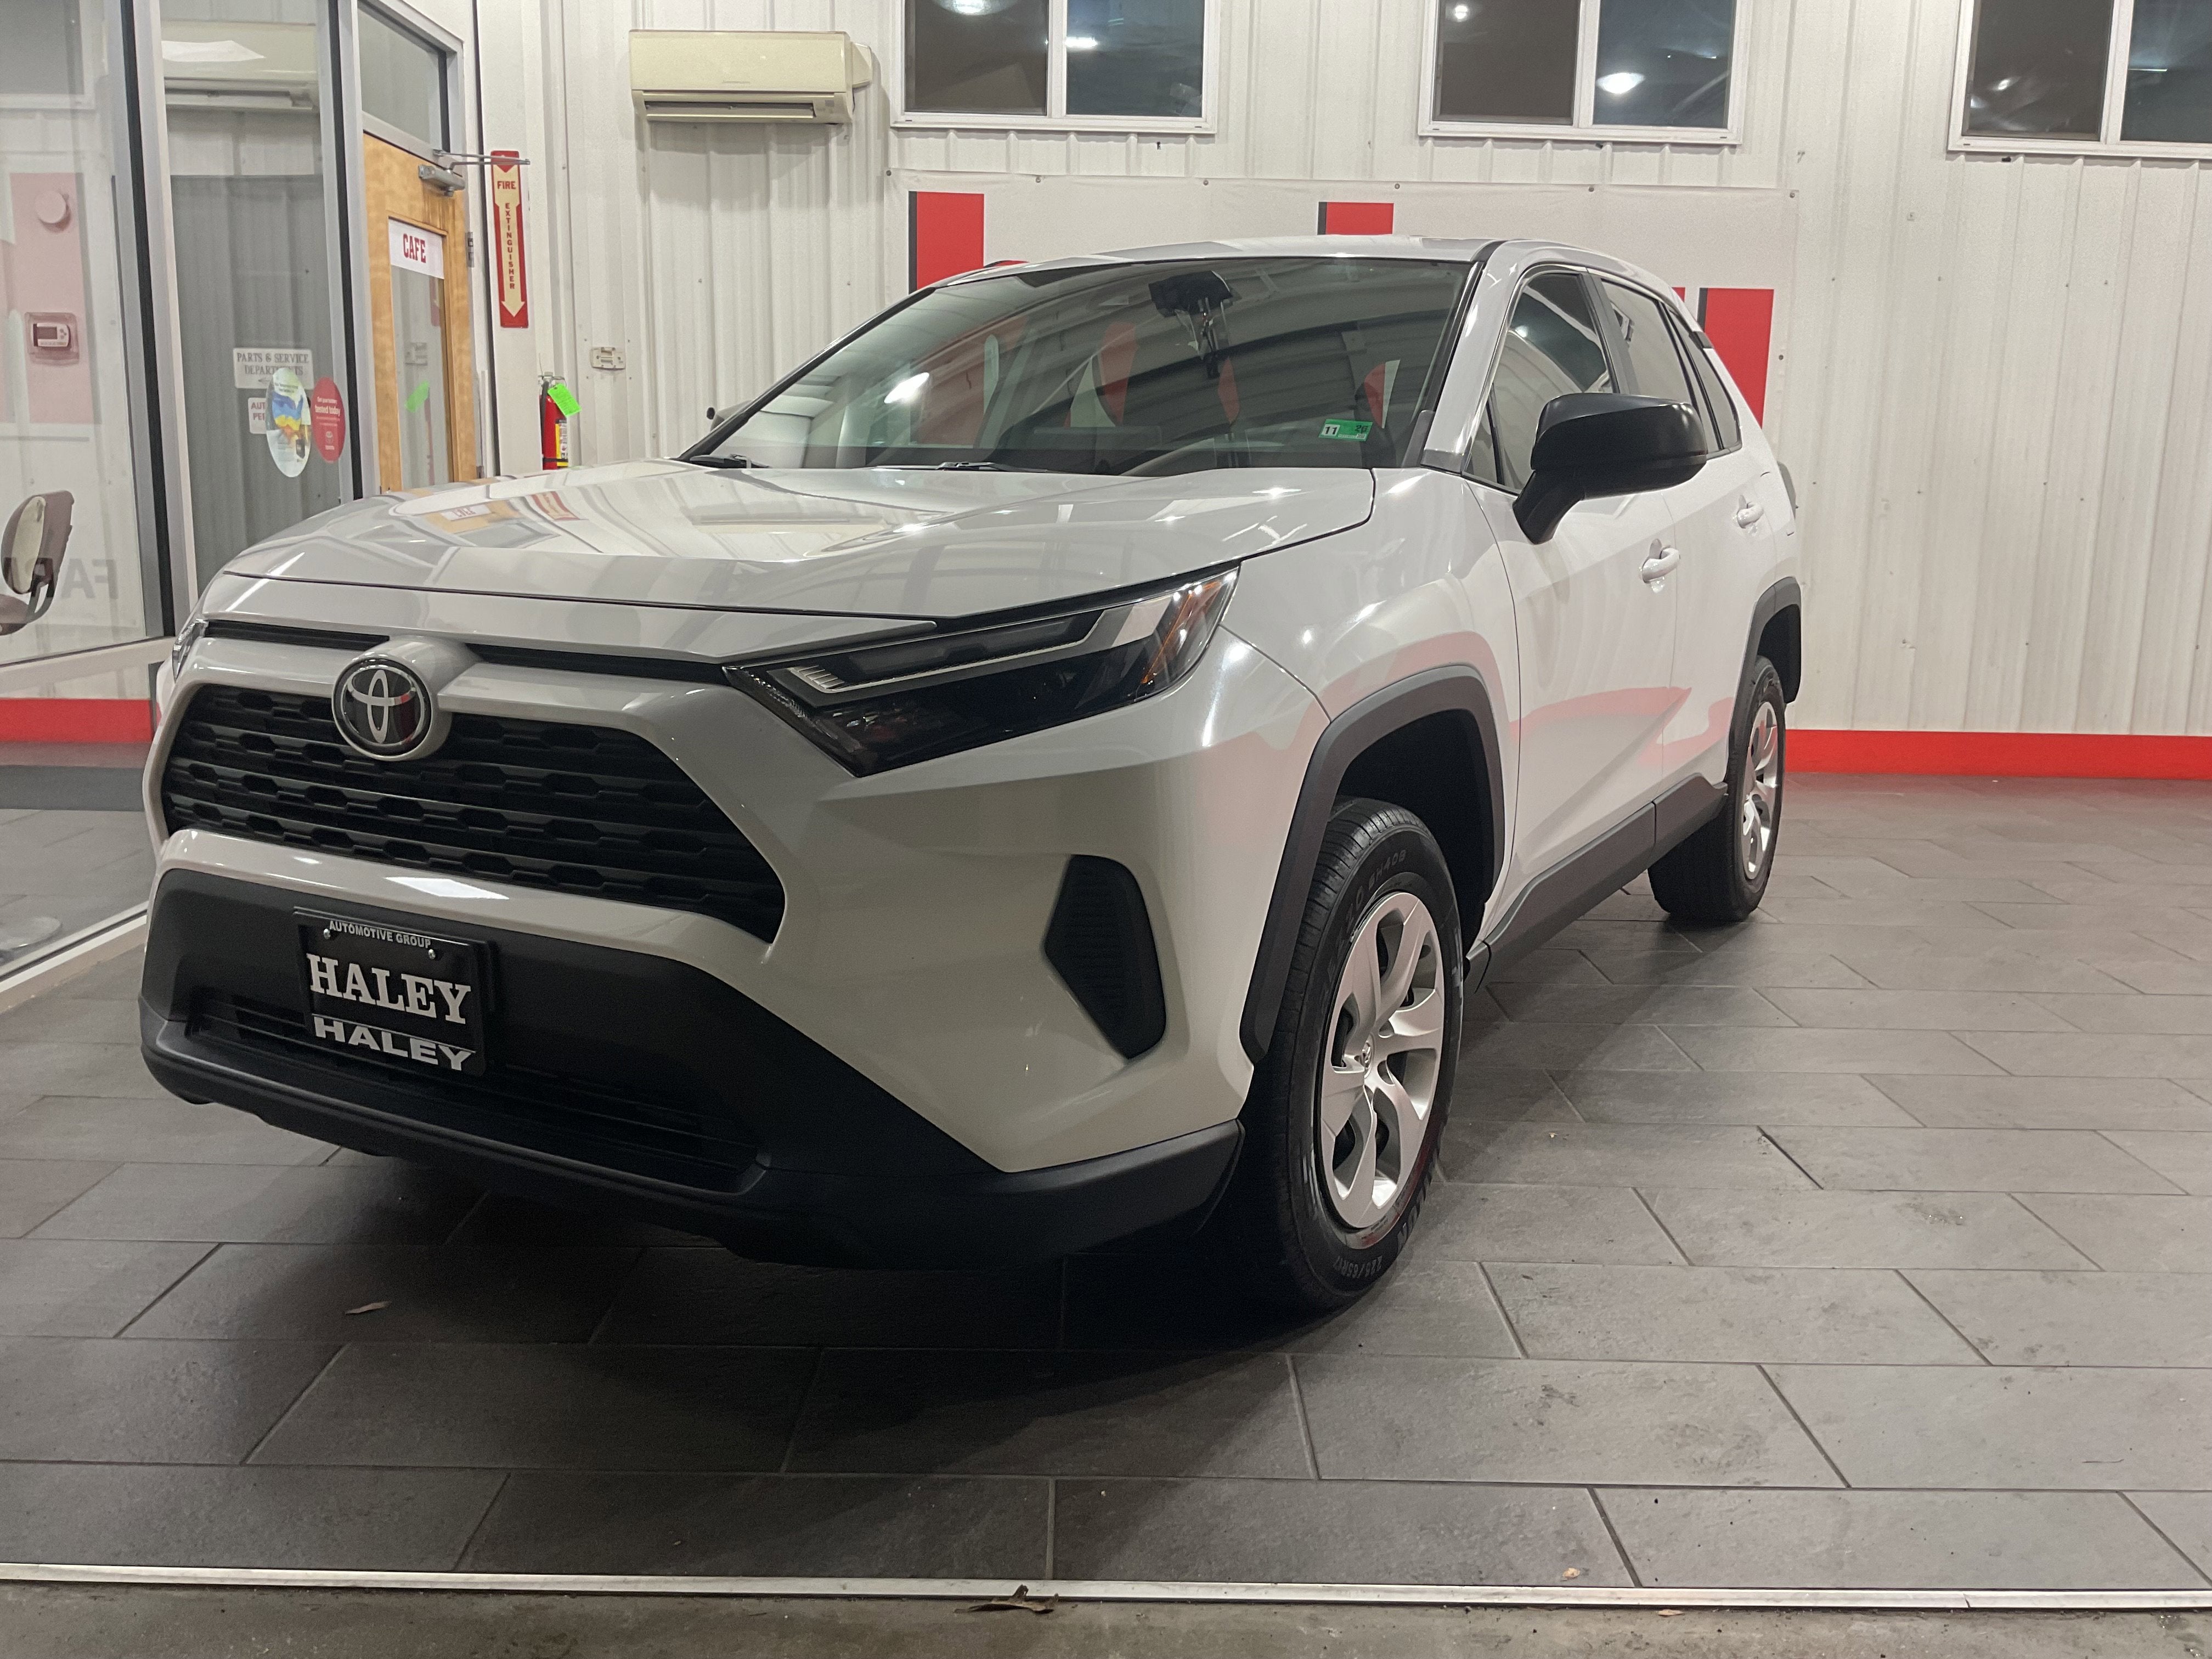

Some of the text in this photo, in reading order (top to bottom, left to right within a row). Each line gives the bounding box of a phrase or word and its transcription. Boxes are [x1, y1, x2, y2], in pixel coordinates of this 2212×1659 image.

[497, 180, 516, 190] FIRE
[403, 233, 426, 263] CAFE
[505, 203, 515, 289] EXTINGUISHER
[237, 353, 309, 363] PARTS & SERVICE
[315, 404, 341, 416] tested today
[1325, 426, 1338, 435] 11
[329, 921, 432, 949] AUTOMOTIVE GROUP
[306, 953, 471, 1025] HALEY
[314, 1016, 471, 1071] HALEY
